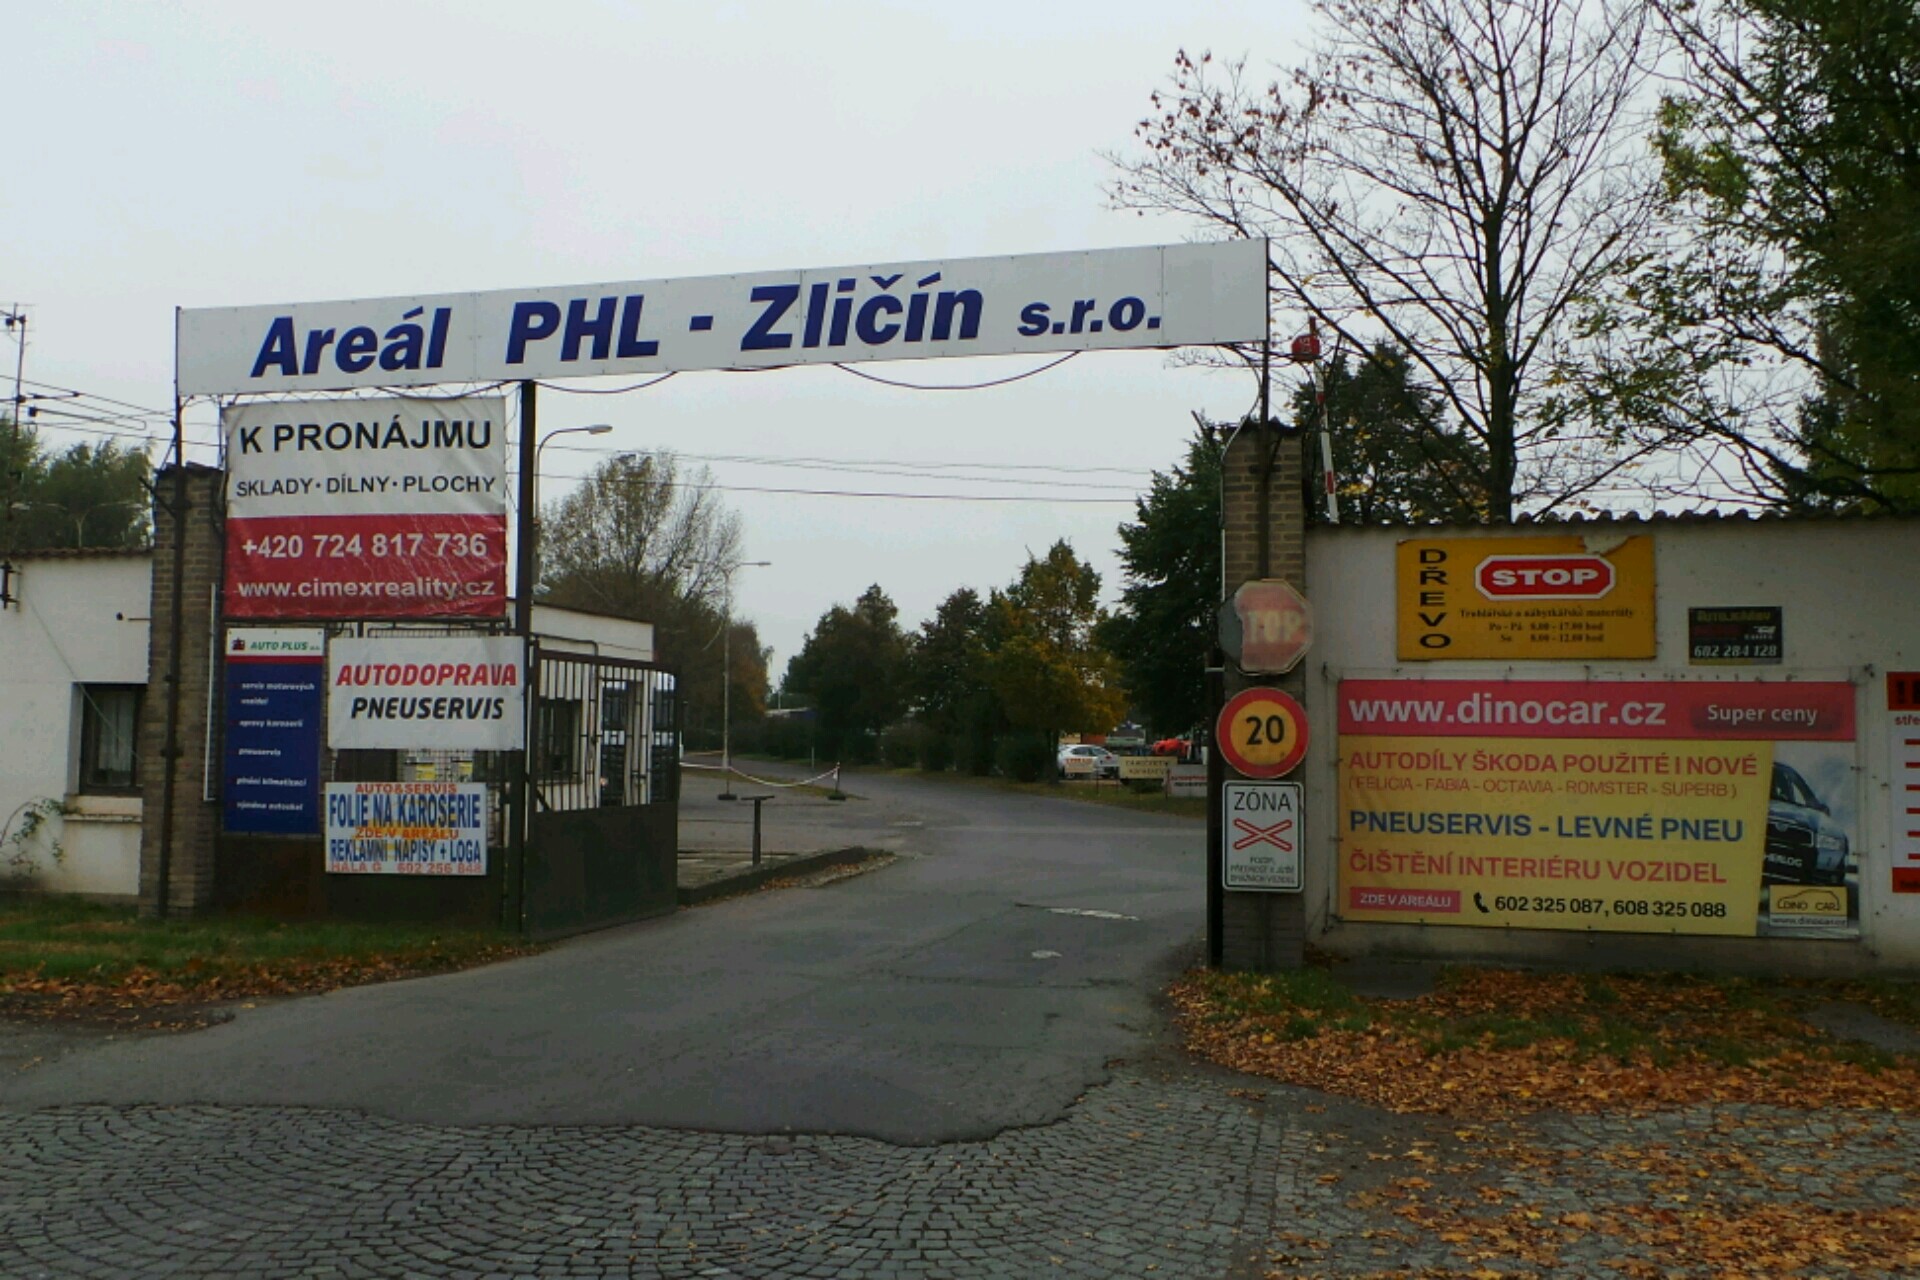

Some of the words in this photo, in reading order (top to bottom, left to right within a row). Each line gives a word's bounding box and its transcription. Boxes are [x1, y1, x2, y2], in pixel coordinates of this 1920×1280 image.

[250, 305, 452, 378] Areál
[505, 295, 659, 364] PHL
[689, 315, 714, 331] -
[740, 272, 984, 352] Zličín
[1017, 297, 1162, 337] s.r.o.
[240, 426, 262, 454] K
[273, 414, 491, 452] PRONÁJMU
[236, 478, 313, 497] SKLADY
[326, 474, 390, 494] DÍLNY
[402, 475, 496, 493] PLOCHY
[242, 535, 303, 558] +420
[313, 534, 362, 558] 724
[372, 533, 423, 557] 817
[434, 533, 487, 557] 736
[238, 578, 496, 600] www.cimexreality.cz
[1492, 568, 1599, 586] STOP
[1418, 549, 1451, 648] DŘEVO
[1246, 610, 1301, 643] TOP
[250, 641, 279, 650] AUTO
[282, 641, 308, 650] PLUS
[335, 663, 517, 687] AUTODOPRAVA
[351, 697, 504, 719] PNEUSERVIS
[1348, 692, 1665, 725] www.dinocar.cz
[1707, 704, 1766, 726] Super
[1771, 707, 1818, 726] ceny
[1245, 715, 1285, 745] 20
[1349, 748, 1468, 770] AUTODÍLY
[1472, 749, 1557, 772] ŠKODA
[1562, 751, 1670, 775] POUŽITÉ
[1675, 757, 1681, 774] I
[1686, 752, 1757, 775] NOVÉ
[1425, 778, 1470, 792] FABIA
[1483, 780, 1553, 793] OCTAVIA
[1566, 781, 1648, 795] ROMSTER
[1661, 782, 1728, 797] SUPERB
[329, 794, 368, 827] FOLIE
[372, 794, 393, 827] NA
[398, 794, 481, 828] KAROSERIE
[1234, 788, 1292, 812] ZÓNA
[1349, 810, 1532, 837] PNEUSERVIS
[1557, 813, 1653, 838] LEVNÉ
[1661, 817, 1743, 842] PNEU
[450, 840, 481, 862] LOGA
[1349, 848, 1454, 875] ČIŠTĚNÍ
[1458, 854, 1601, 880] INTERIÉRU
[1607, 860, 1727, 883] VOZIDEL
[1360, 893, 1385, 905] ZDE
[1387, 894, 1395, 905] V
[1395, 893, 1451, 908] AREÁLU
[1495, 896, 1528, 912] 602
[1532, 897, 1566, 913] 325
[1613, 900, 1649, 915] 608
[1652, 901, 1687, 916] 325
[1691, 902, 1727, 917] 088
[1784, 901, 1808, 910] DINO
[1815, 902, 1836, 911] CAR
